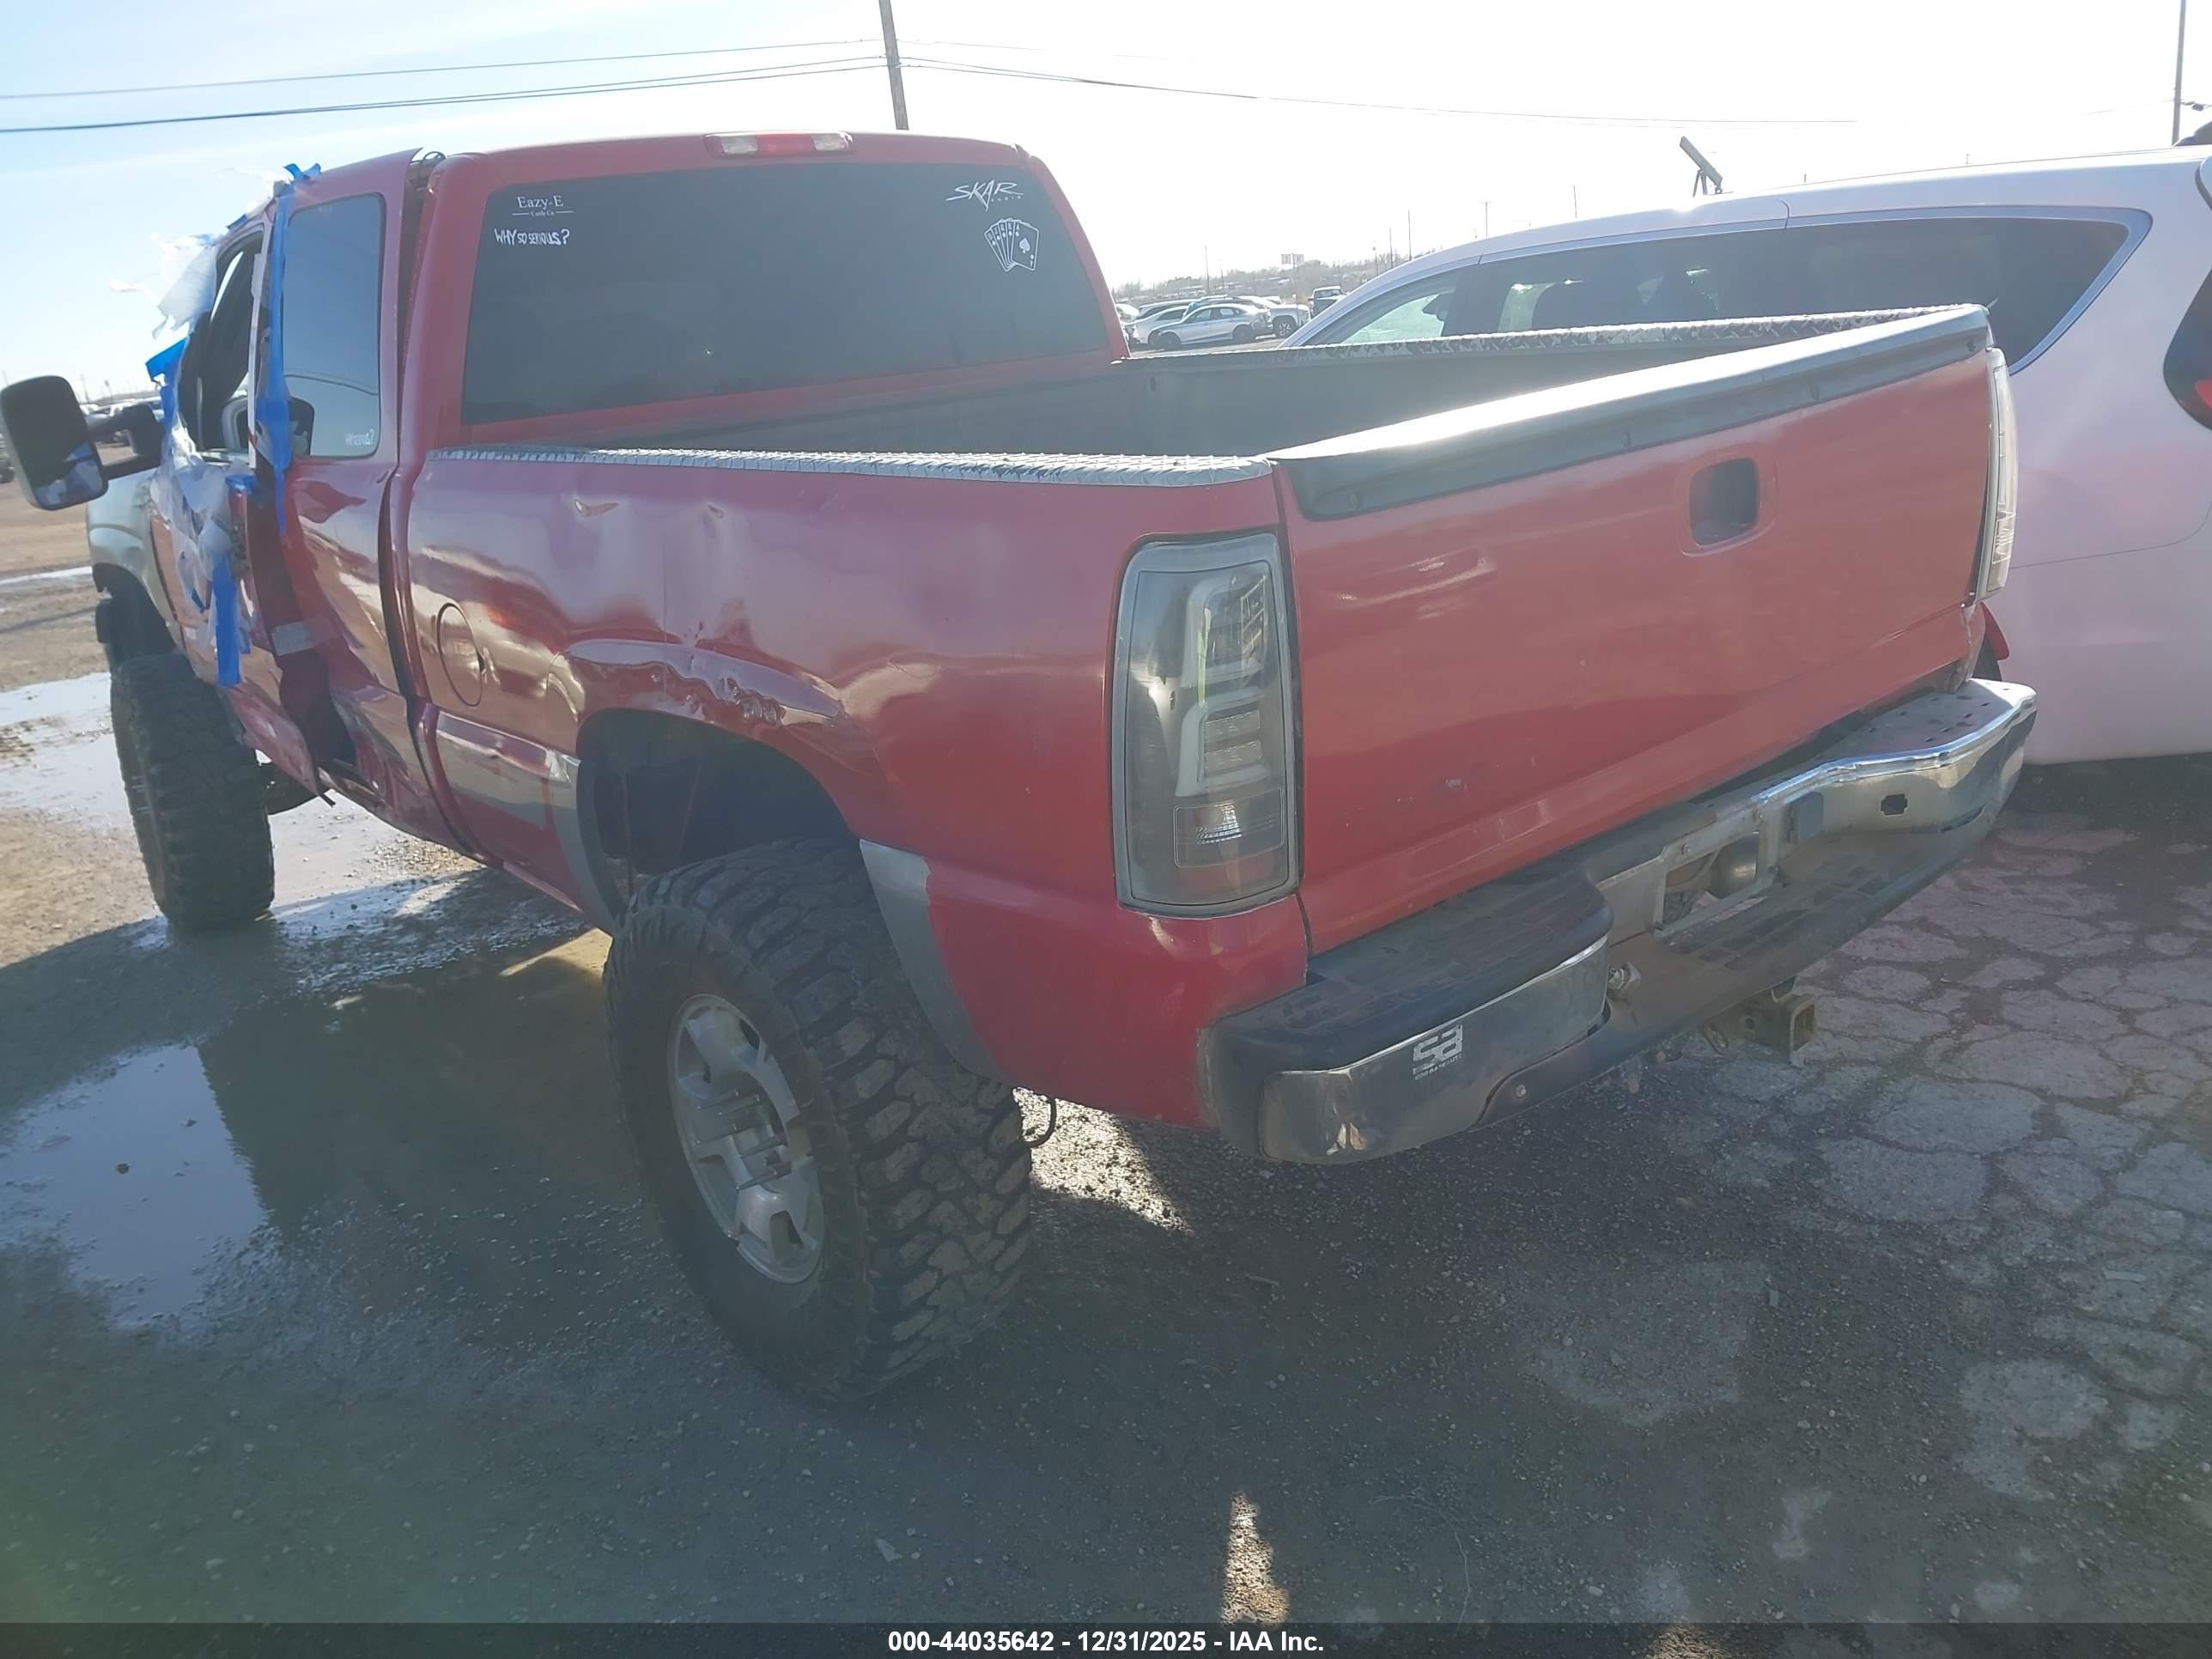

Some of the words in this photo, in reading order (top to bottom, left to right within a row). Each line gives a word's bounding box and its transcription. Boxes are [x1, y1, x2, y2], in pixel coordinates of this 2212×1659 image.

[517, 195, 564, 210] Eazy-E
[945, 179, 1024, 212] SKAR
[494, 228, 517, 246] WHY
[517, 233, 527, 246] SO
[528, 228, 570, 246] SERIOUS?
